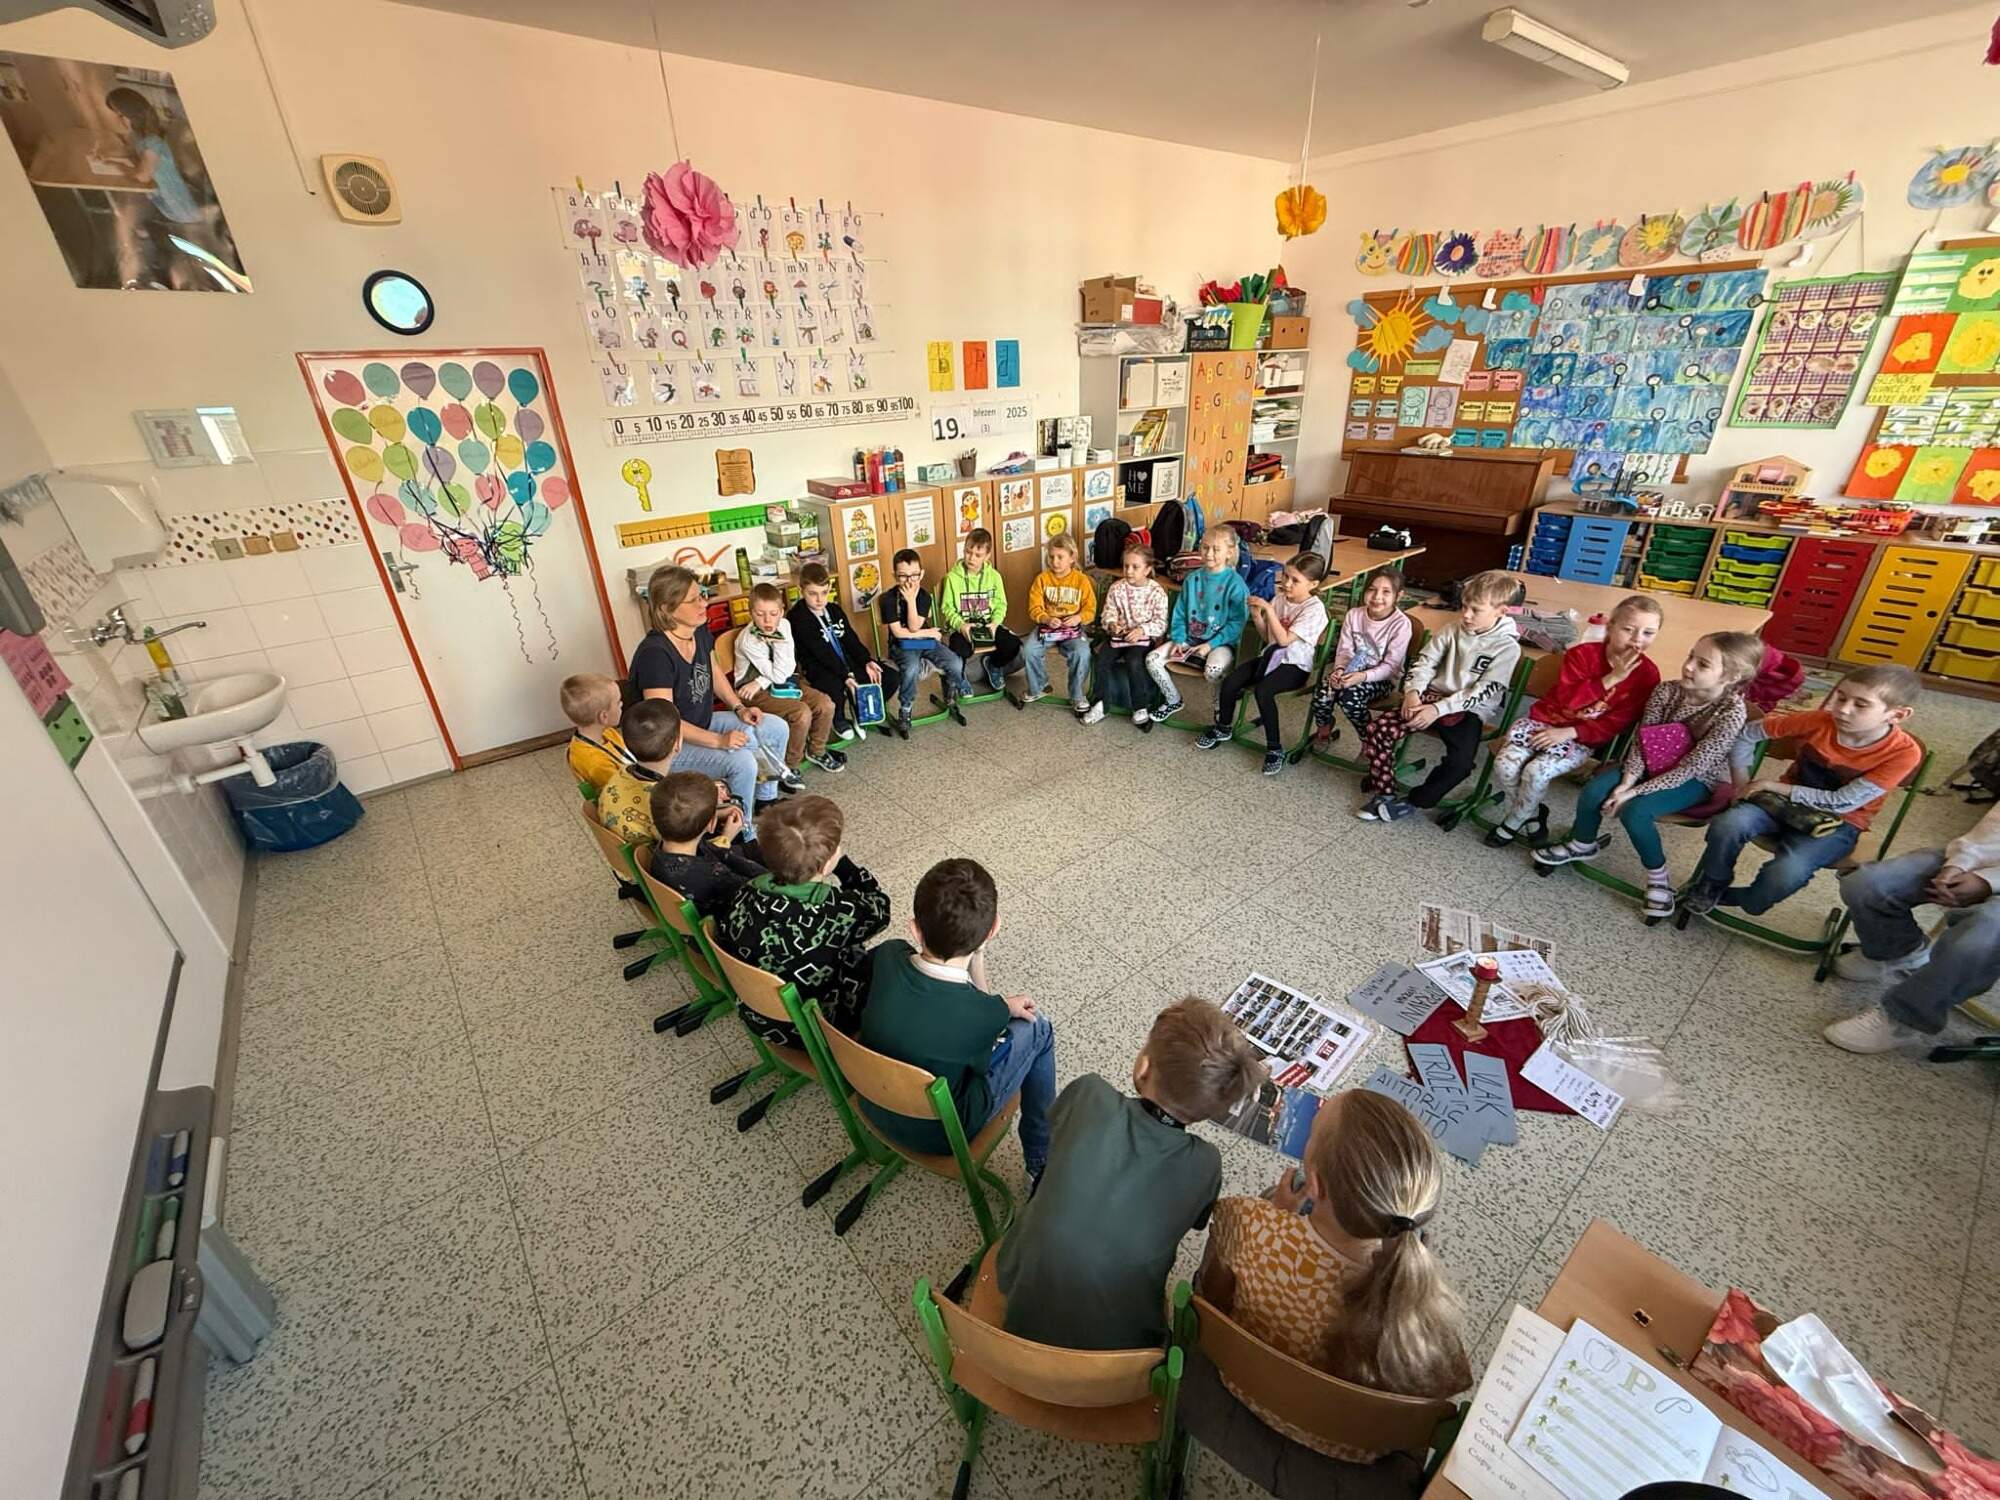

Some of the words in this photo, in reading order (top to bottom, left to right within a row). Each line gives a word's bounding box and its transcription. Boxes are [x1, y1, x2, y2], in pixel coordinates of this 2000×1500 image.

[569, 197, 576, 206] a
[584, 196, 595, 208] A
[784, 214, 790, 222] e
[796, 212, 803, 223] E
[824, 214, 830, 224] F
[853, 215, 862, 226] G
[581, 253, 590, 266] h
[597, 254, 607, 266] H
[725, 260, 732, 271] k
[737, 260, 746, 272] K
[770, 262, 776, 272] L
[788, 264, 796, 272] m
[800, 262, 808, 272] M
[829, 262, 837, 272] N
[592, 310, 599, 319] o
[606, 307, 616, 318] O
[678, 310, 688, 324] Q
[705, 312, 710, 320] r
[715, 310, 725, 320] R
[776, 310, 782, 320] S
[704, 364, 716, 374] W
[736, 364, 742, 372] x
[748, 362, 756, 372] X
[778, 363, 784, 373] y
[788, 358, 796, 370] Y
[822, 359, 829, 369] Z
[602, 367, 610, 376] u
[616, 365, 627, 376] U
[665, 365, 674, 375] V
[1196, 362, 1205, 376] A
[1206, 368, 1214, 384] B
[1216, 362, 1224, 376] C
[1194, 396, 1200, 410] E
[1214, 392, 1221, 406] G
[614, 421, 624, 434] 0
[634, 422, 641, 432] 5
[648, 416, 662, 432] 10
[666, 420, 676, 430] 15
[680, 415, 694, 429] 20
[698, 418, 709, 427] 25
[711, 412, 726, 426] 30
[730, 416, 740, 424] 35
[742, 410, 756, 424] 40
[758, 412, 768, 422] 45
[770, 408, 784, 420] 50
[786, 410, 796, 419] 55
[800, 404, 812, 418] 60
[814, 408, 824, 417] 65
[826, 402, 838, 416] 70
[842, 406, 850, 414] 75
[852, 400, 864, 414] 80
[866, 404, 874, 413] 85
[876, 399, 888, 412] 90
[899, 397, 914, 410] 100
[1006, 406, 1028, 418] 2025
[934, 418, 966, 441] 19.
[1200, 431, 1206, 445] J
[1212, 423, 1220, 438] K
[1222, 426, 1227, 439] L
[1225, 450, 1233, 464] O
[1128, 470, 1136, 481] H
[1004, 484, 1010, 494] 1
[1128, 482, 1144, 494] ME
[1004, 496, 1010, 504] 2
[1232, 500, 1238, 513] X
[1005, 523, 1012, 532] A
[1005, 532, 1012, 542] B
[1005, 543, 1012, 552] C
[1471, 1072, 1508, 1118] VLAK
[1618, 1362, 1657, 1397] P
